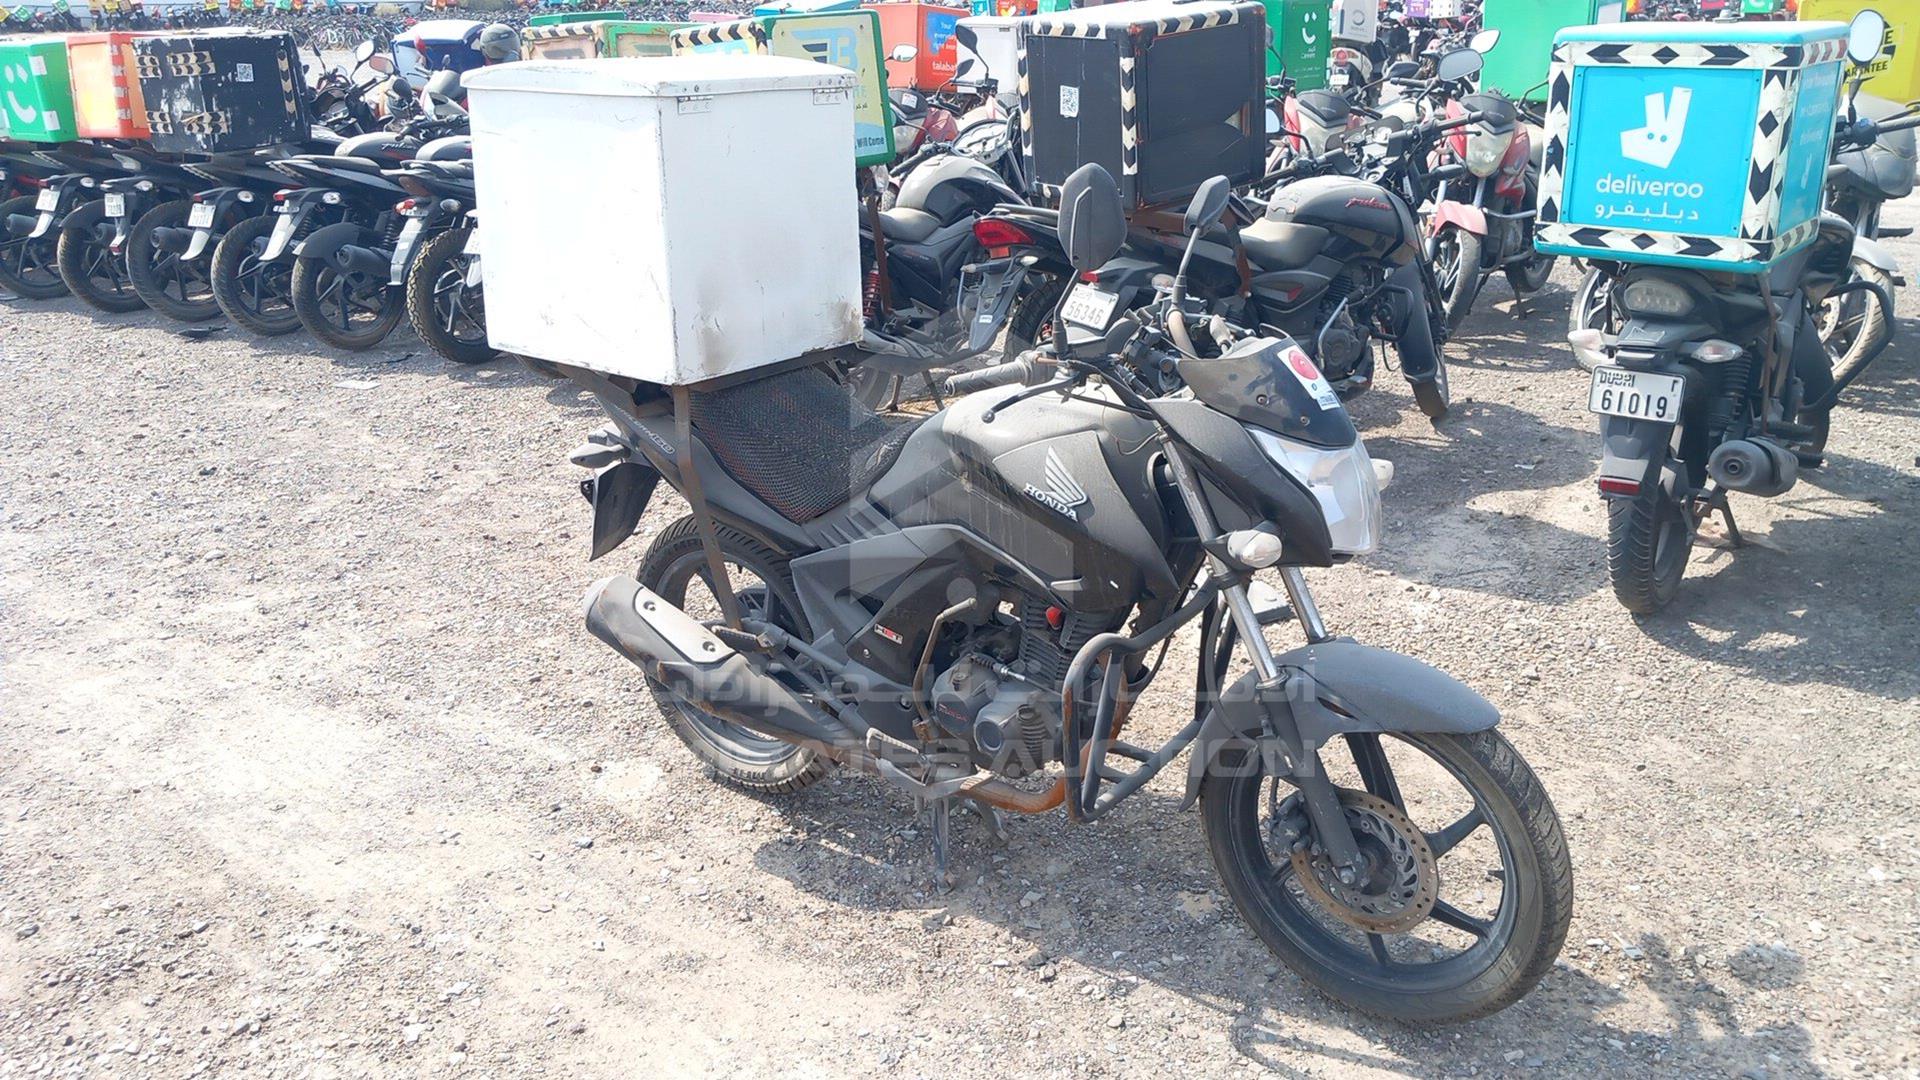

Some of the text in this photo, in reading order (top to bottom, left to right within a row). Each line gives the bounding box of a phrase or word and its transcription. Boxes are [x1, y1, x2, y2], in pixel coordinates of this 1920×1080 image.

[1595, 172, 1704, 199] deliveroo
[1594, 200, 1699, 225] ديليفرو
[1601, 389, 1668, 418] 61019
[1023, 482, 1078, 522] HONDA
